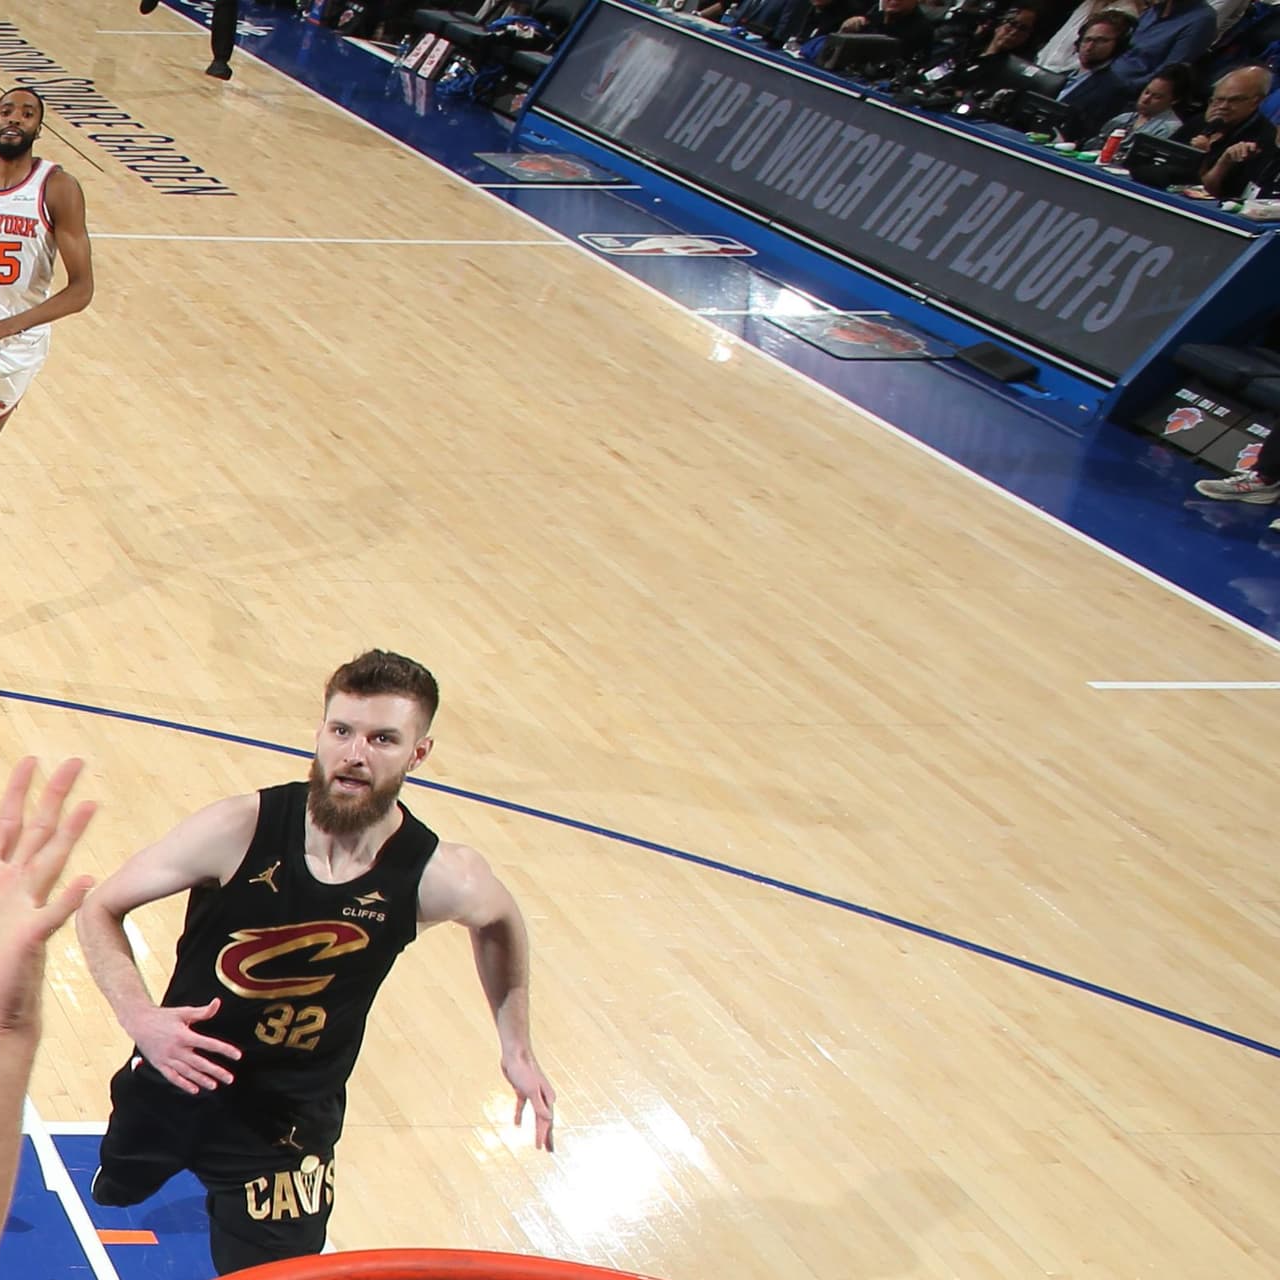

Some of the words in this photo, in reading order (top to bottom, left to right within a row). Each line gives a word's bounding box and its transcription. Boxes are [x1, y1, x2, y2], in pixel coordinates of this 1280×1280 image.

[14, 76, 145, 129] SQUARE
[87, 133, 239, 197] GARDEN
[664, 69, 752, 152] TAP
[715, 91, 792, 172] TO
[756, 107, 906, 221] WATCH
[861, 153, 979, 251] THE
[926, 181, 1174, 333] PLAYOFFS
[342, 906, 386, 923] CLIFFS
[254, 1002, 328, 1051] 32
